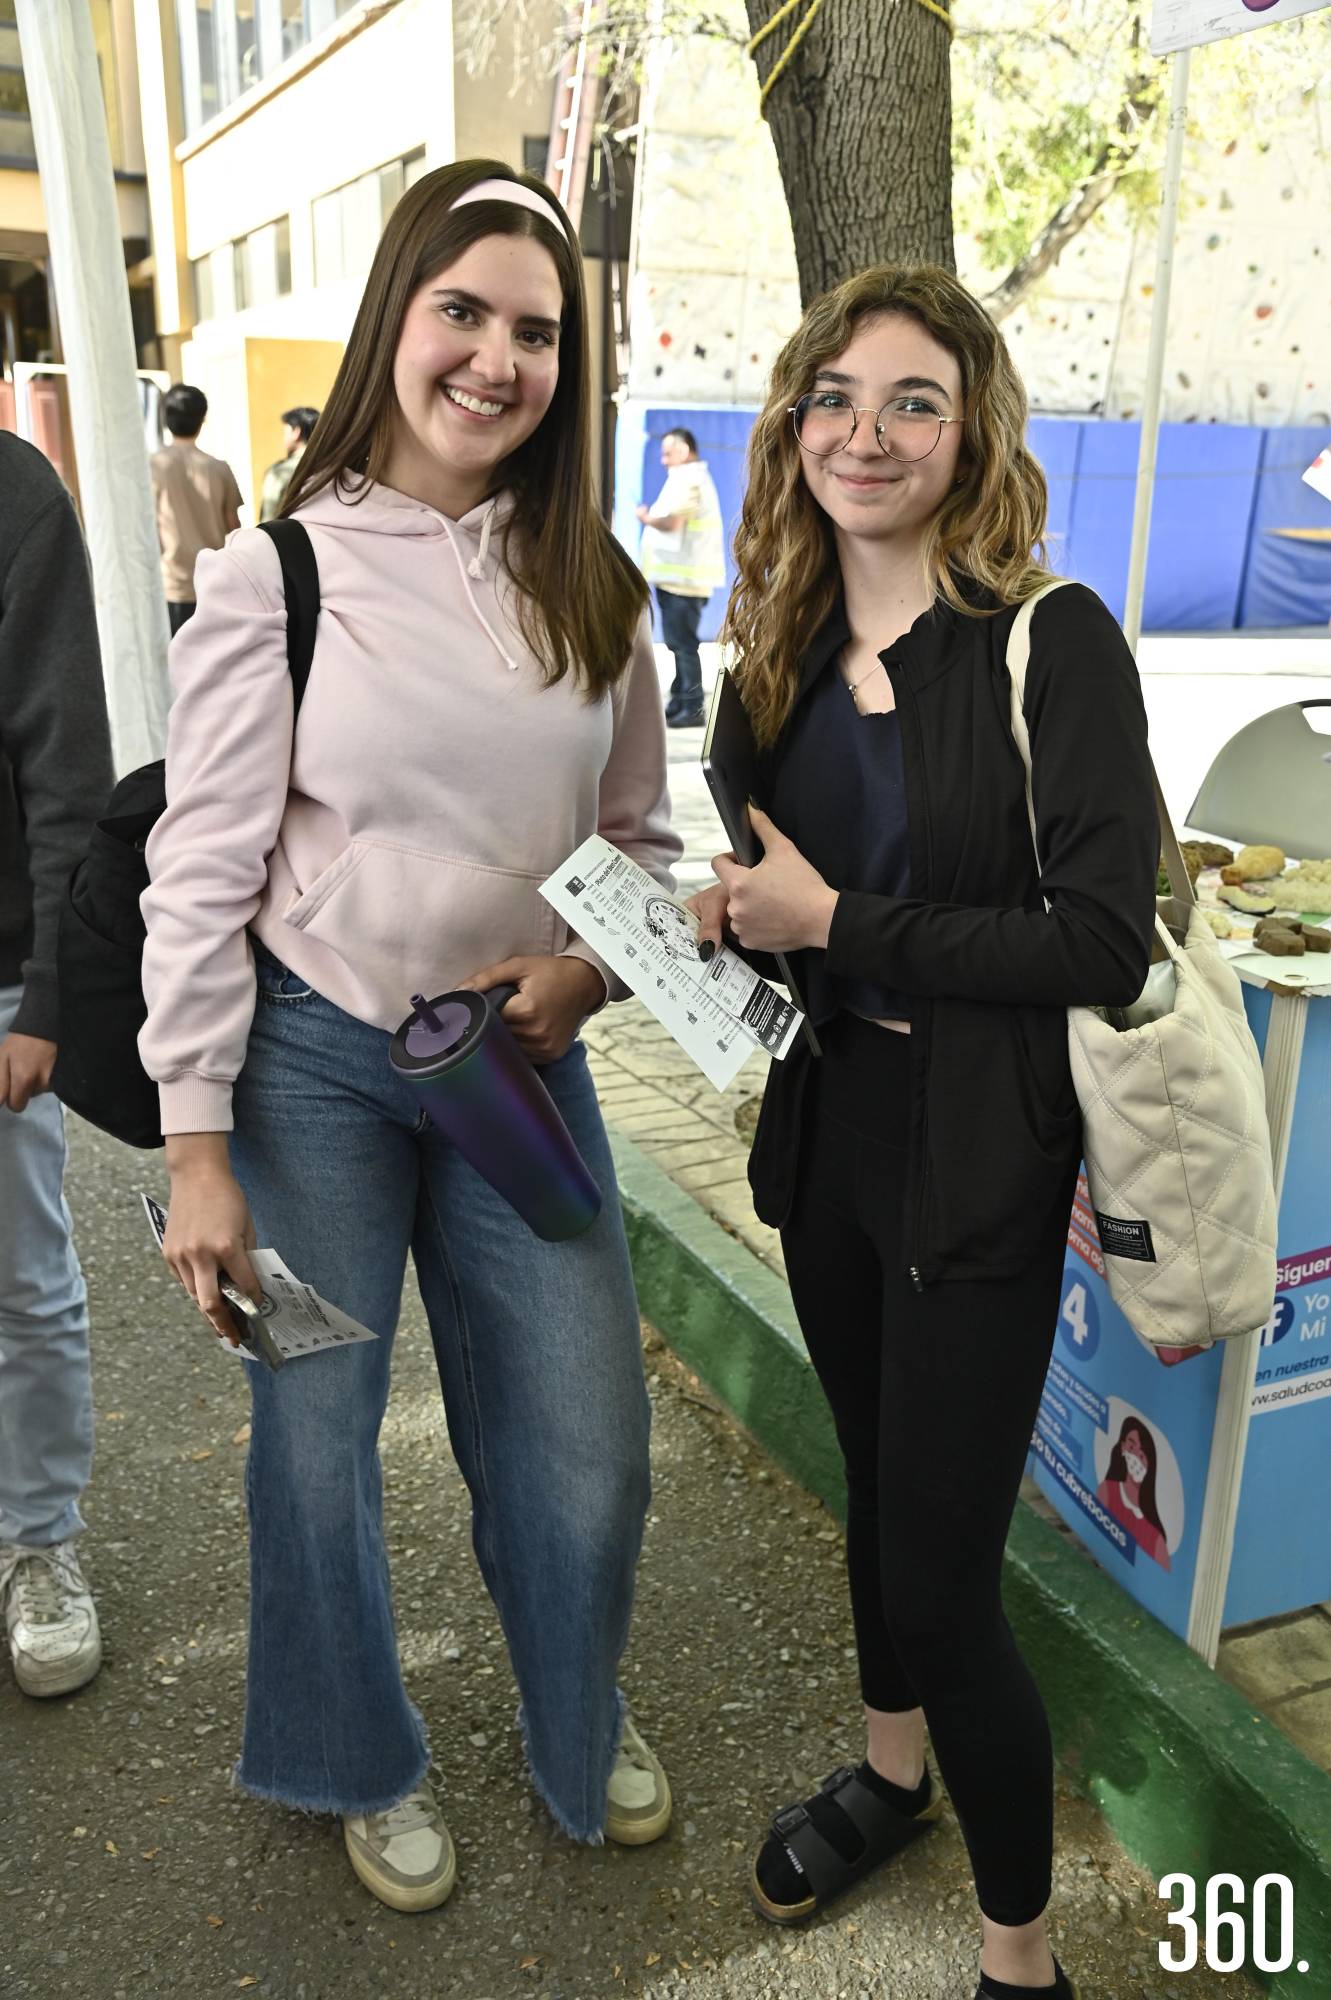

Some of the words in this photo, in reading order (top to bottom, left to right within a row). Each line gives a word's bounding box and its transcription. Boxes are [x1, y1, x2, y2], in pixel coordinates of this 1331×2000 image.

[1103, 1221, 1139, 1235] FASHION
[1062, 1283, 1088, 1346] 4
[1305, 1293, 1329, 1313] Yo
[1300, 1316, 1327, 1341] Mi
[1275, 1354, 1329, 1376] nuestra
[1056, 1462, 1126, 1547] cubrebocas
